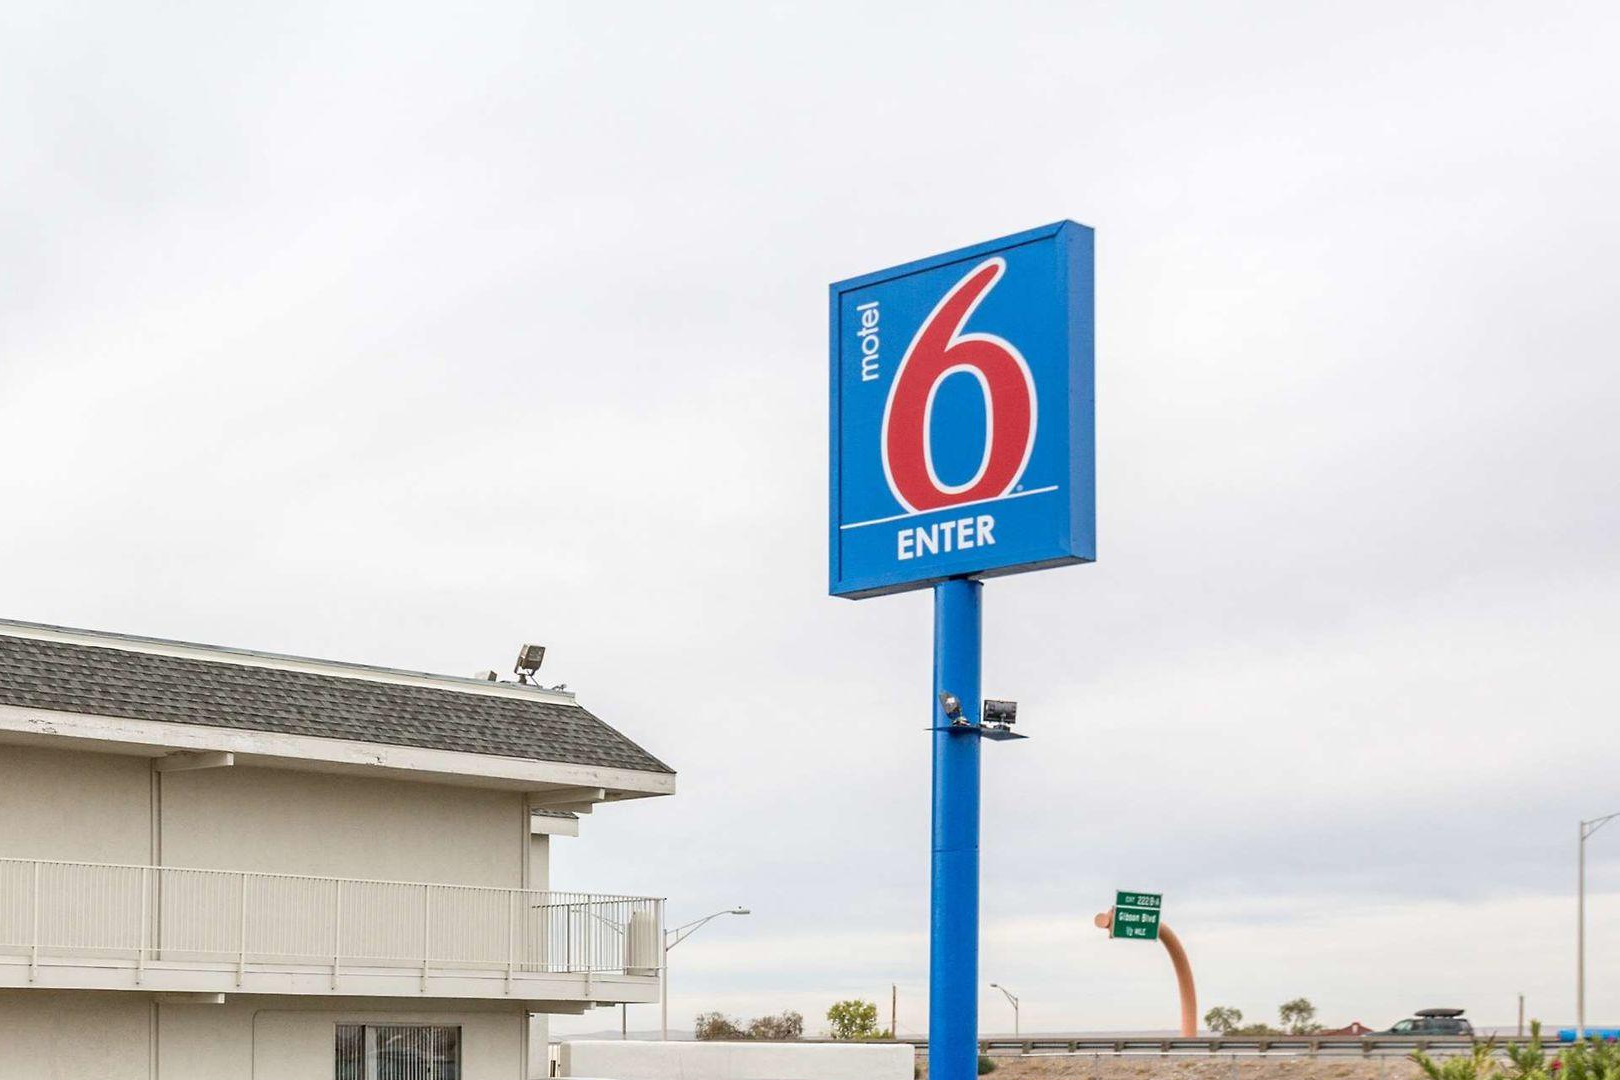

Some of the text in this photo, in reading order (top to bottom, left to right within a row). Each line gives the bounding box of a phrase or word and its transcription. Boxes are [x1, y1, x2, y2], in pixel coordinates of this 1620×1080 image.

[856, 300, 880, 382] motel
[881, 256, 1038, 515] 6
[897, 514, 996, 561] ENTER
[1141, 913, 1157, 923] Blvd
